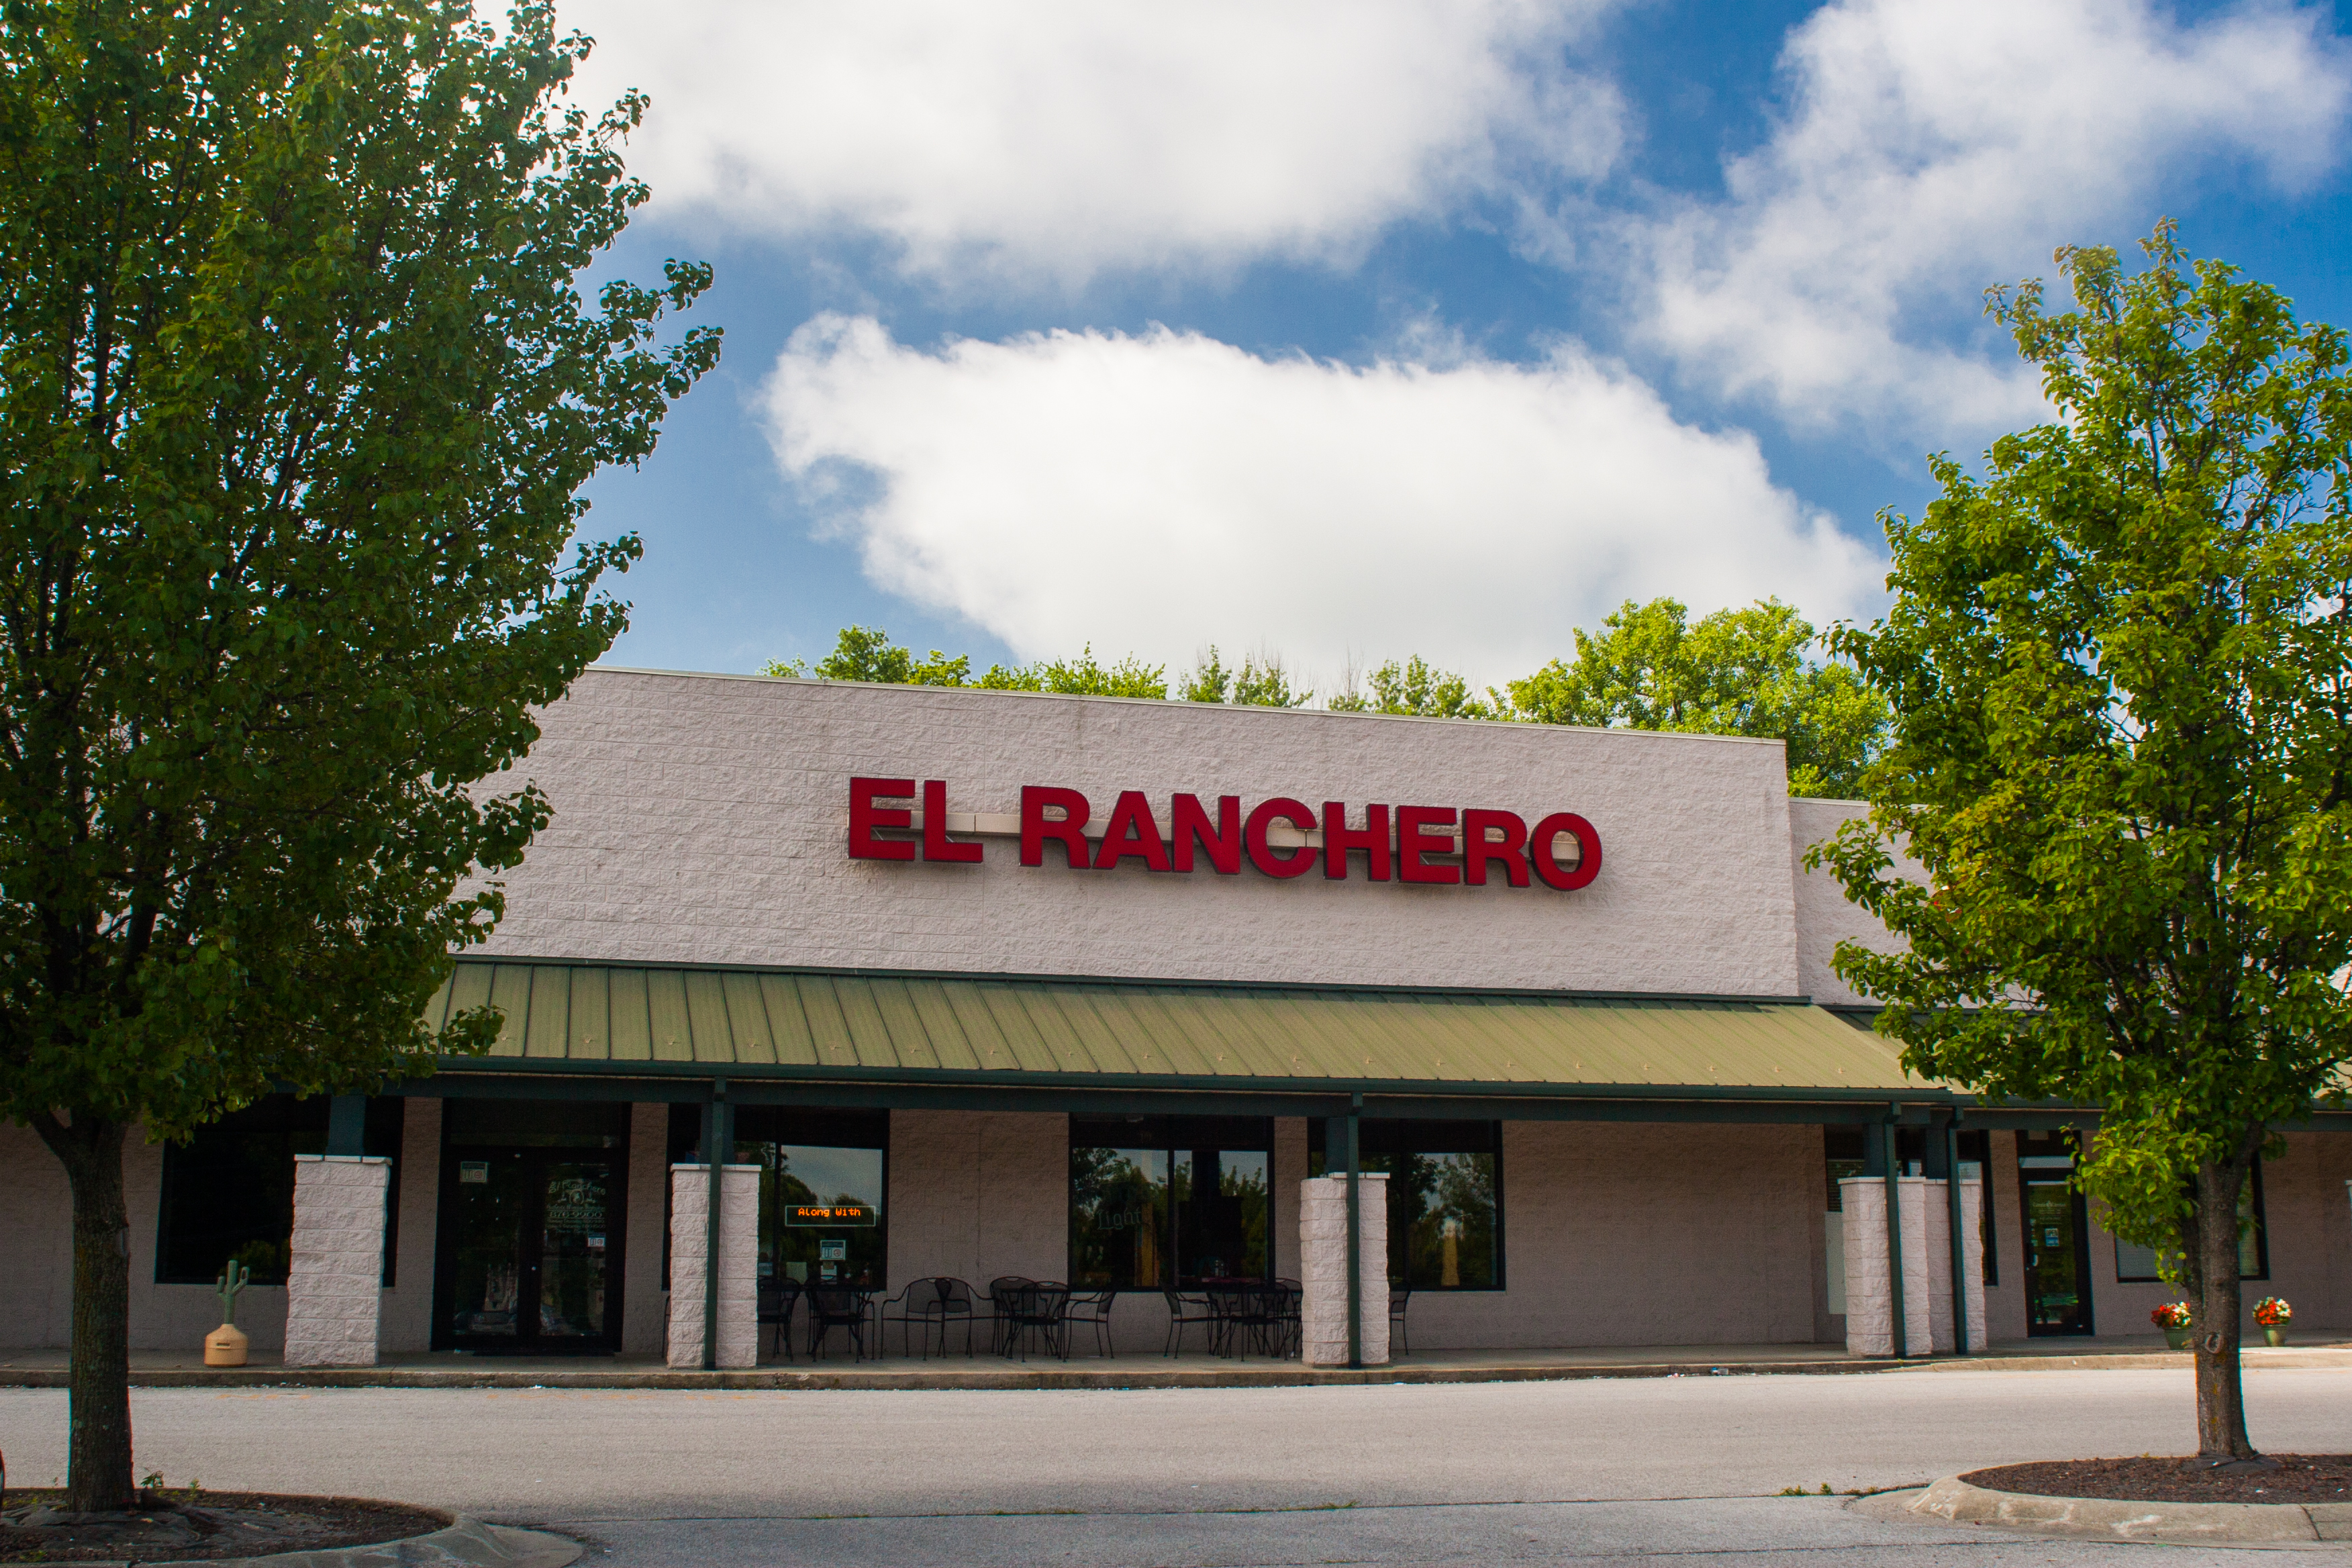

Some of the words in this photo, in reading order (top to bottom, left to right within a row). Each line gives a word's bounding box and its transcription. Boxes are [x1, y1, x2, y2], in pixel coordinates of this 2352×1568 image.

[848, 777, 983, 863] EL
[1019, 785, 1603, 892] RANCHERO
[562, 1180, 606, 1195] Ranchero
[798, 1208, 830, 1217] Along
[836, 1208, 861, 1216] With
[1097, 1207, 1142, 1230] Light
